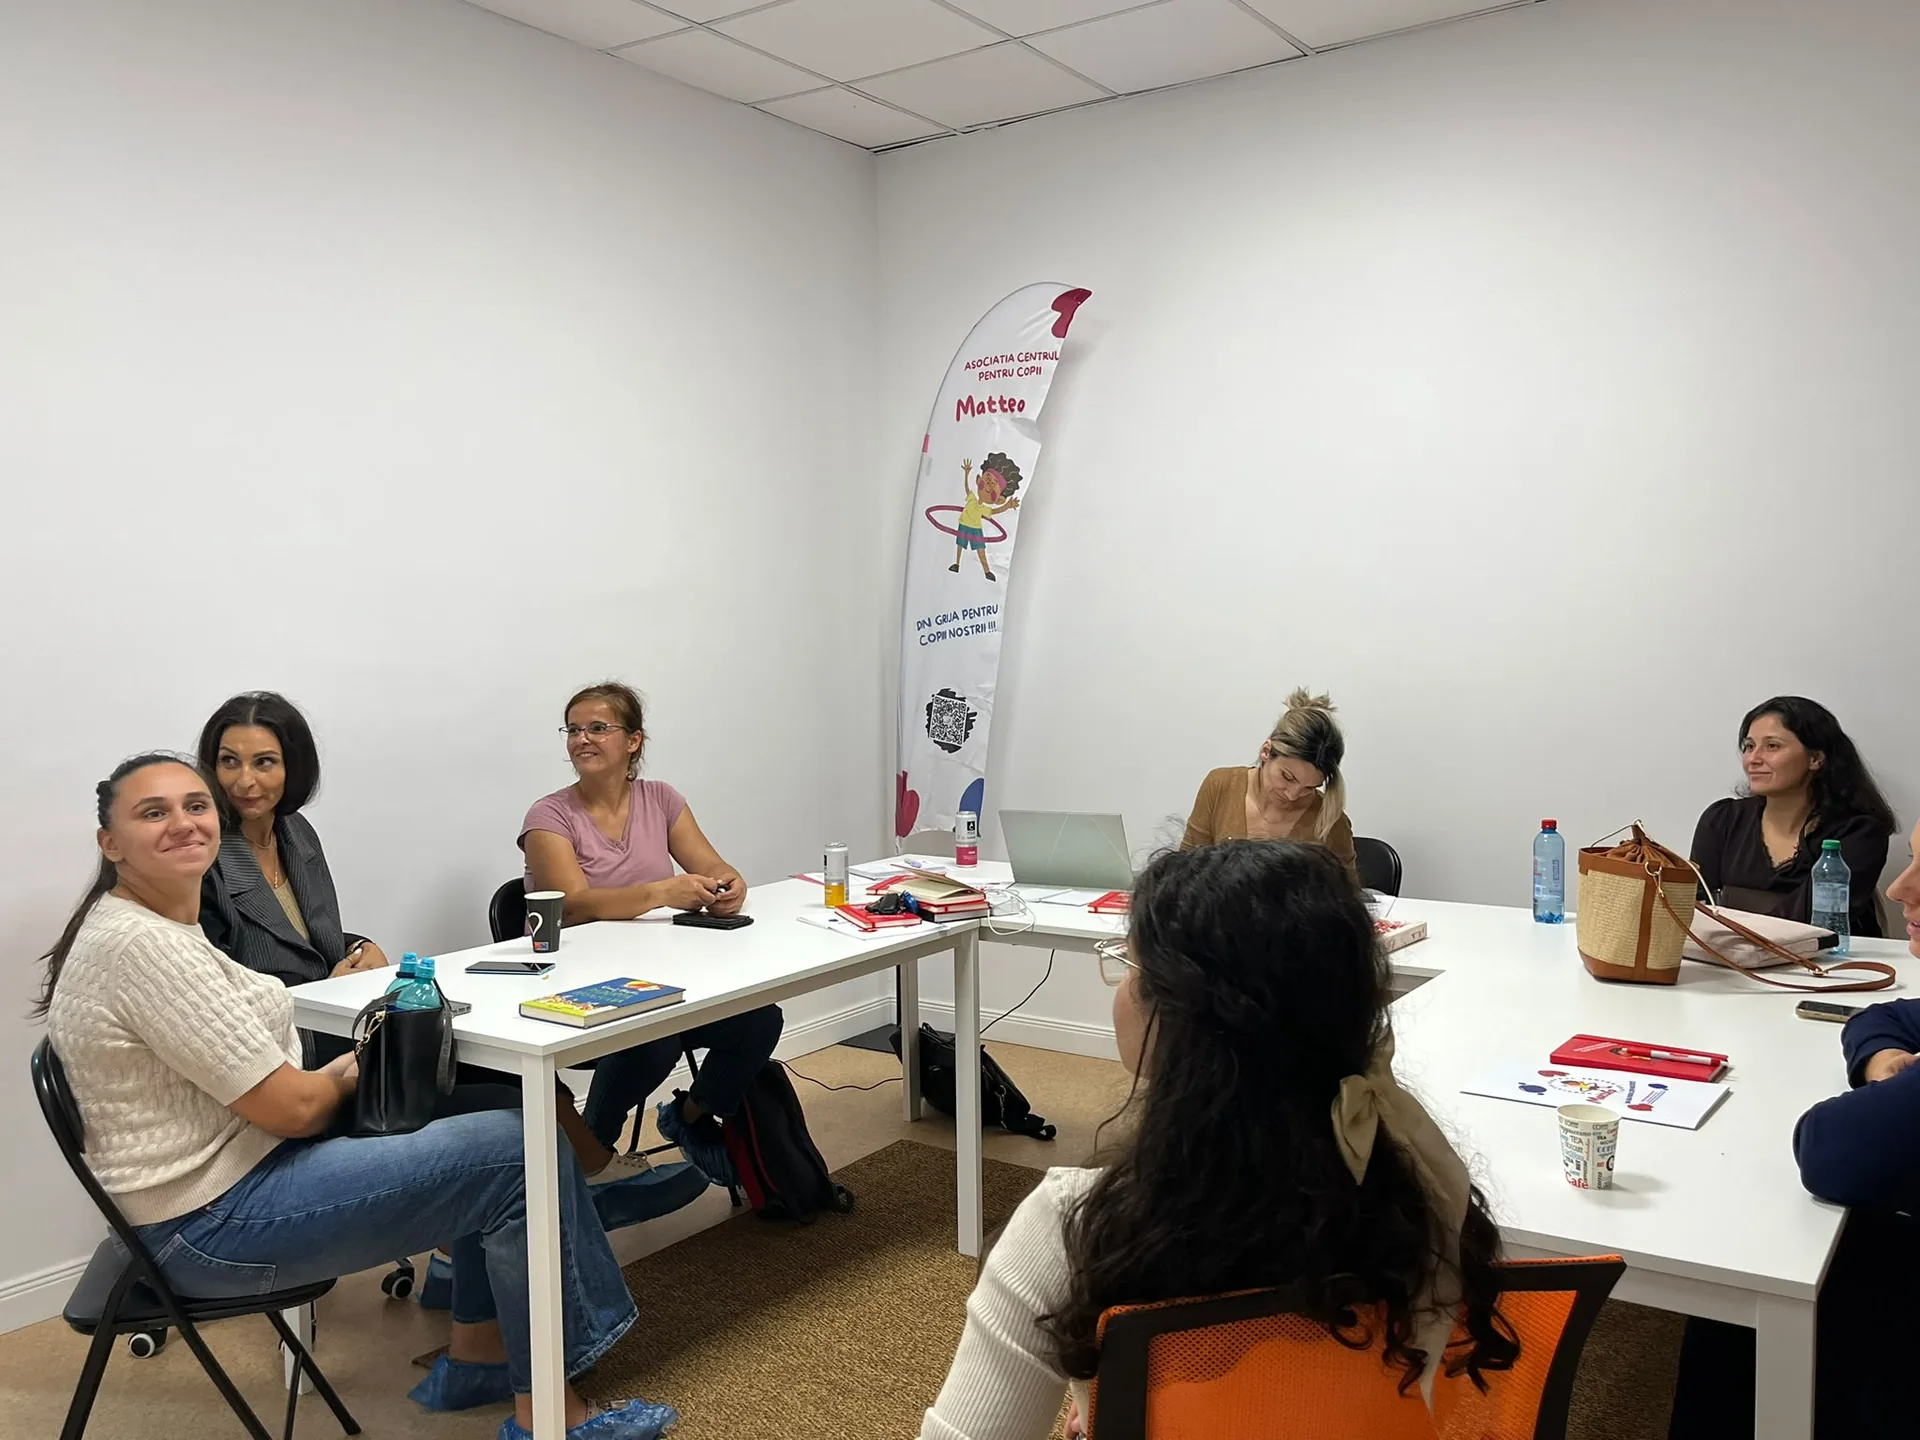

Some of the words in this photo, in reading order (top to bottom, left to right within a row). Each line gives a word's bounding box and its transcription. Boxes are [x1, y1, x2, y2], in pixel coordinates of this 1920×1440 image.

[964, 353, 1014, 371] ASOCIATIA
[1017, 351, 1059, 363] CENTRUL
[978, 369, 1014, 381] PENTRU
[1016, 366, 1042, 378] COPII
[956, 395, 1025, 422] Matteo
[935, 611, 959, 626] GRIJA
[962, 604, 999, 620] PENTRU
[919, 630, 947, 646] COPII
[948, 623, 987, 639] NOSTRII
